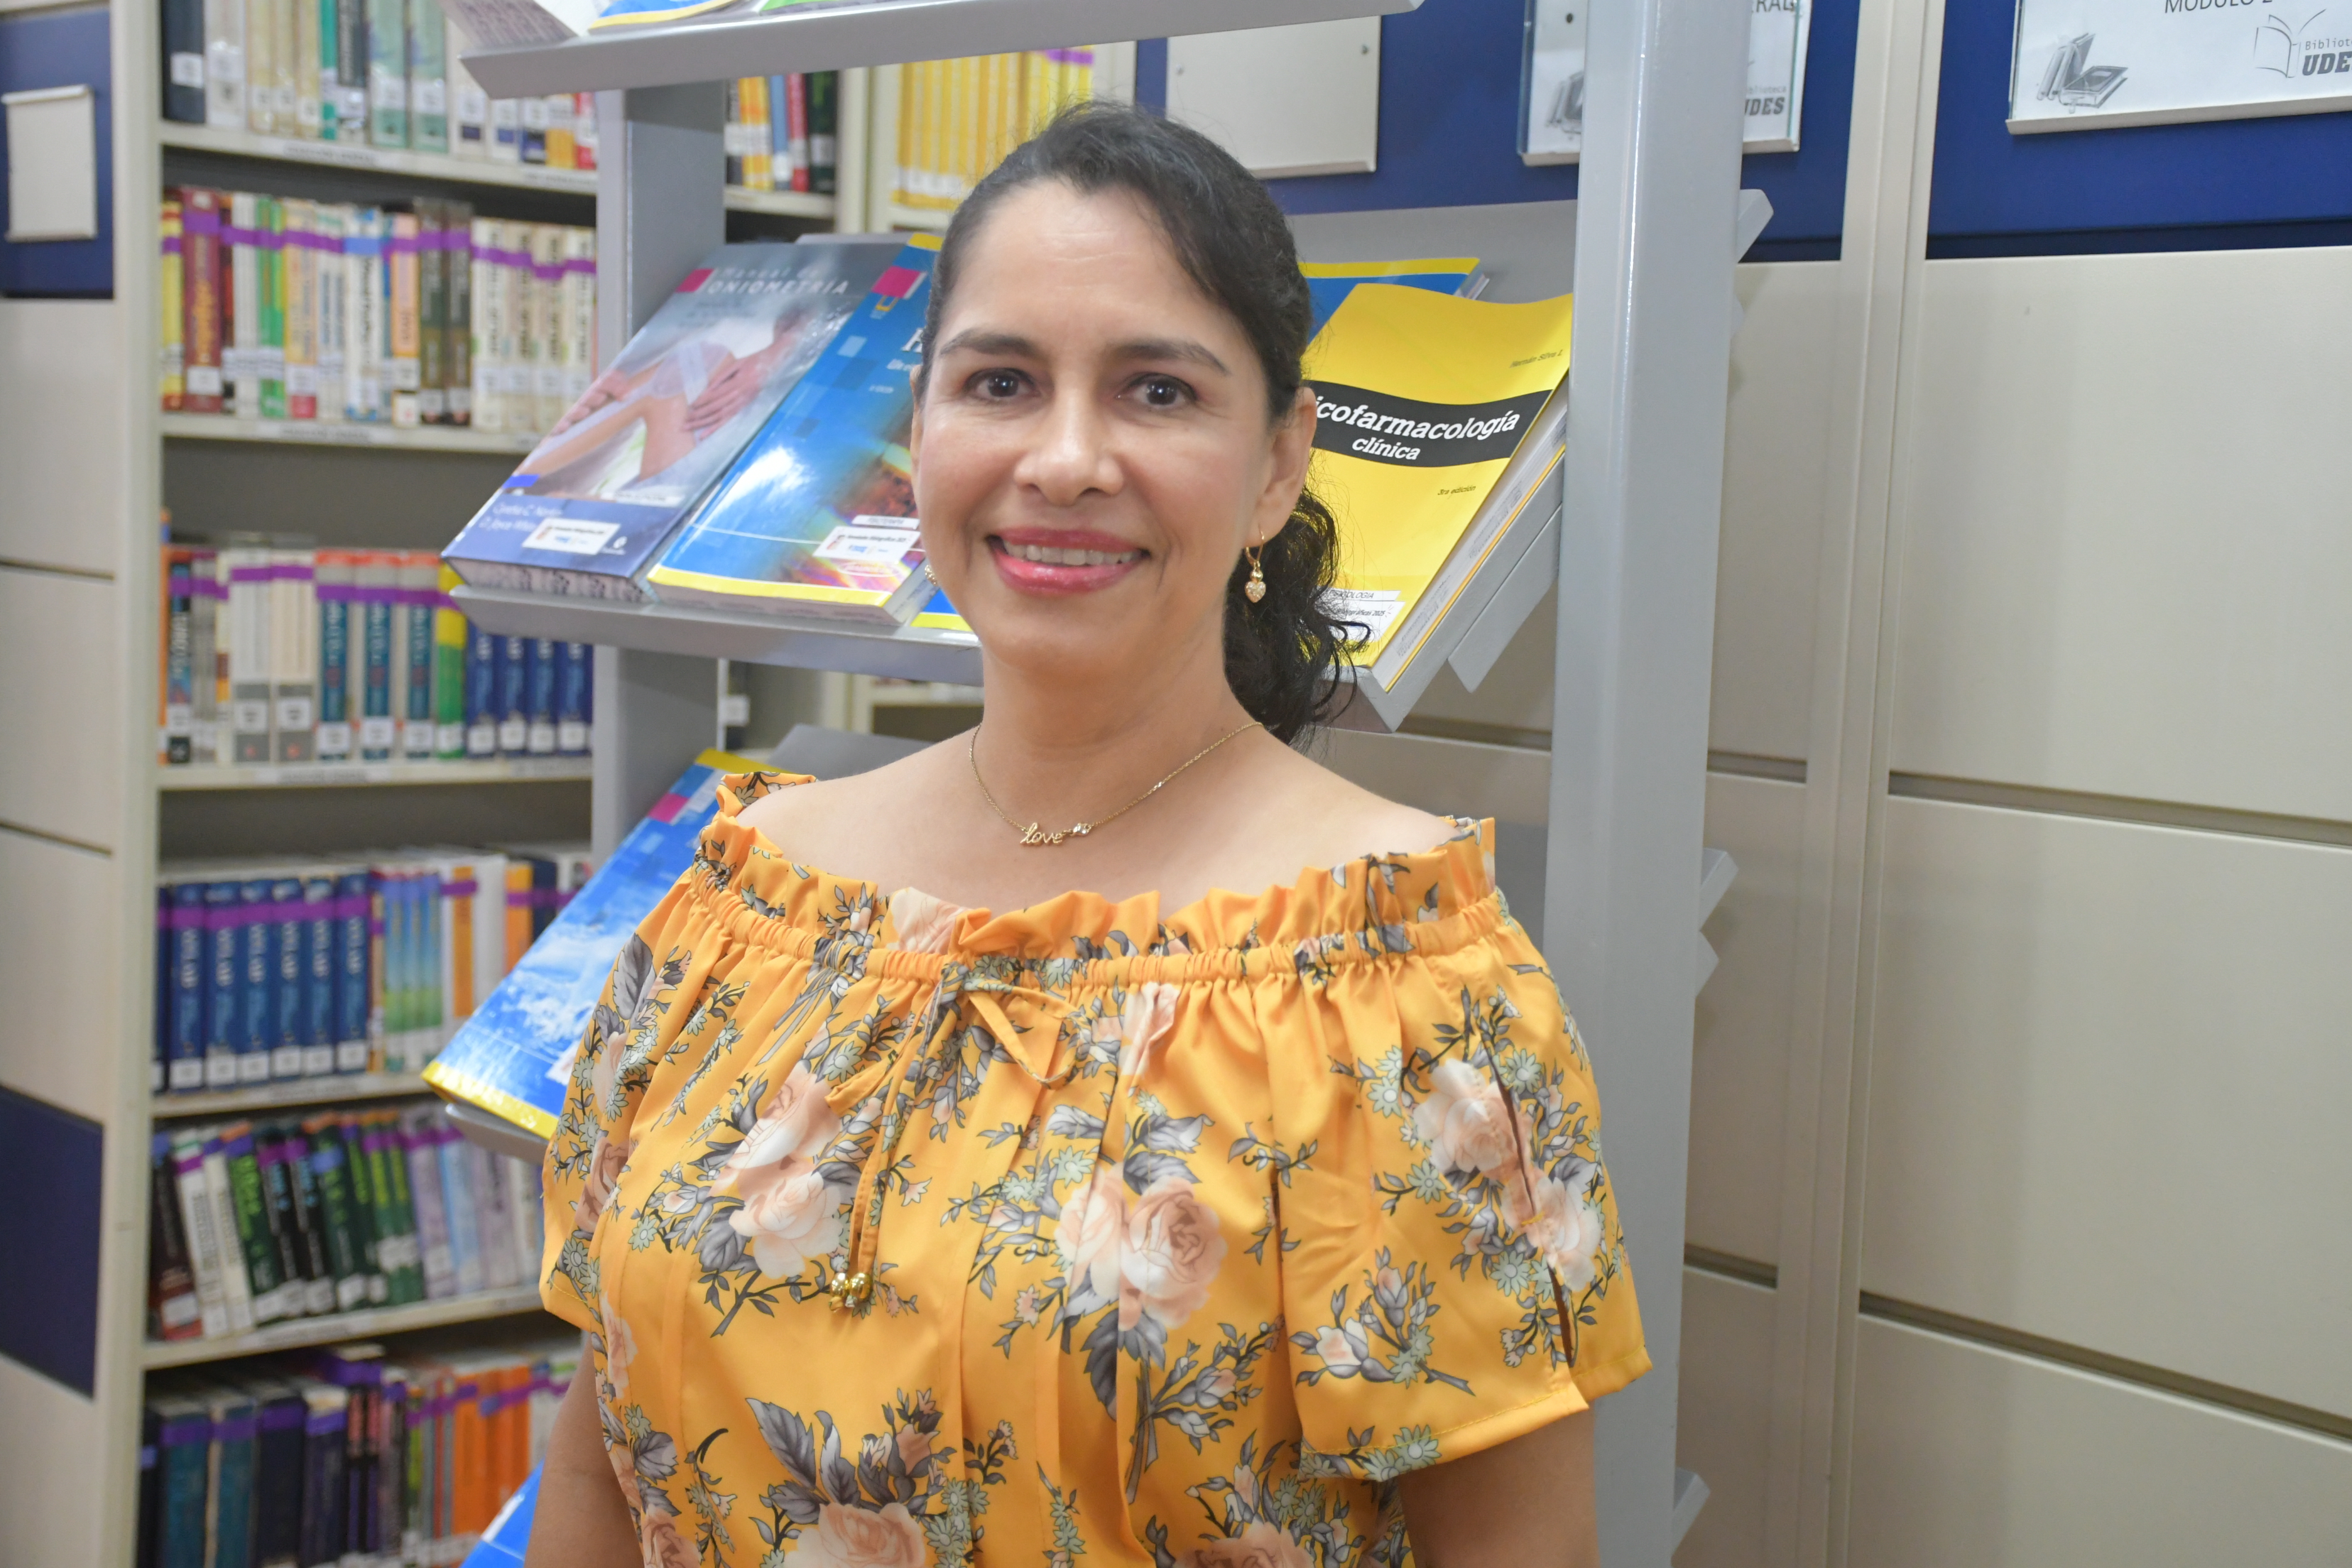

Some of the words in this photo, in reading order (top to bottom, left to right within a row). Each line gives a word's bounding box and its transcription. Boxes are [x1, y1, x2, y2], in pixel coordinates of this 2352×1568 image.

[1752, 0, 1793, 13] RAL
[2305, 38, 2352, 51] Bibliot
[2302, 51, 2352, 76] UDE
[1352, 437, 1420, 460] clínica
